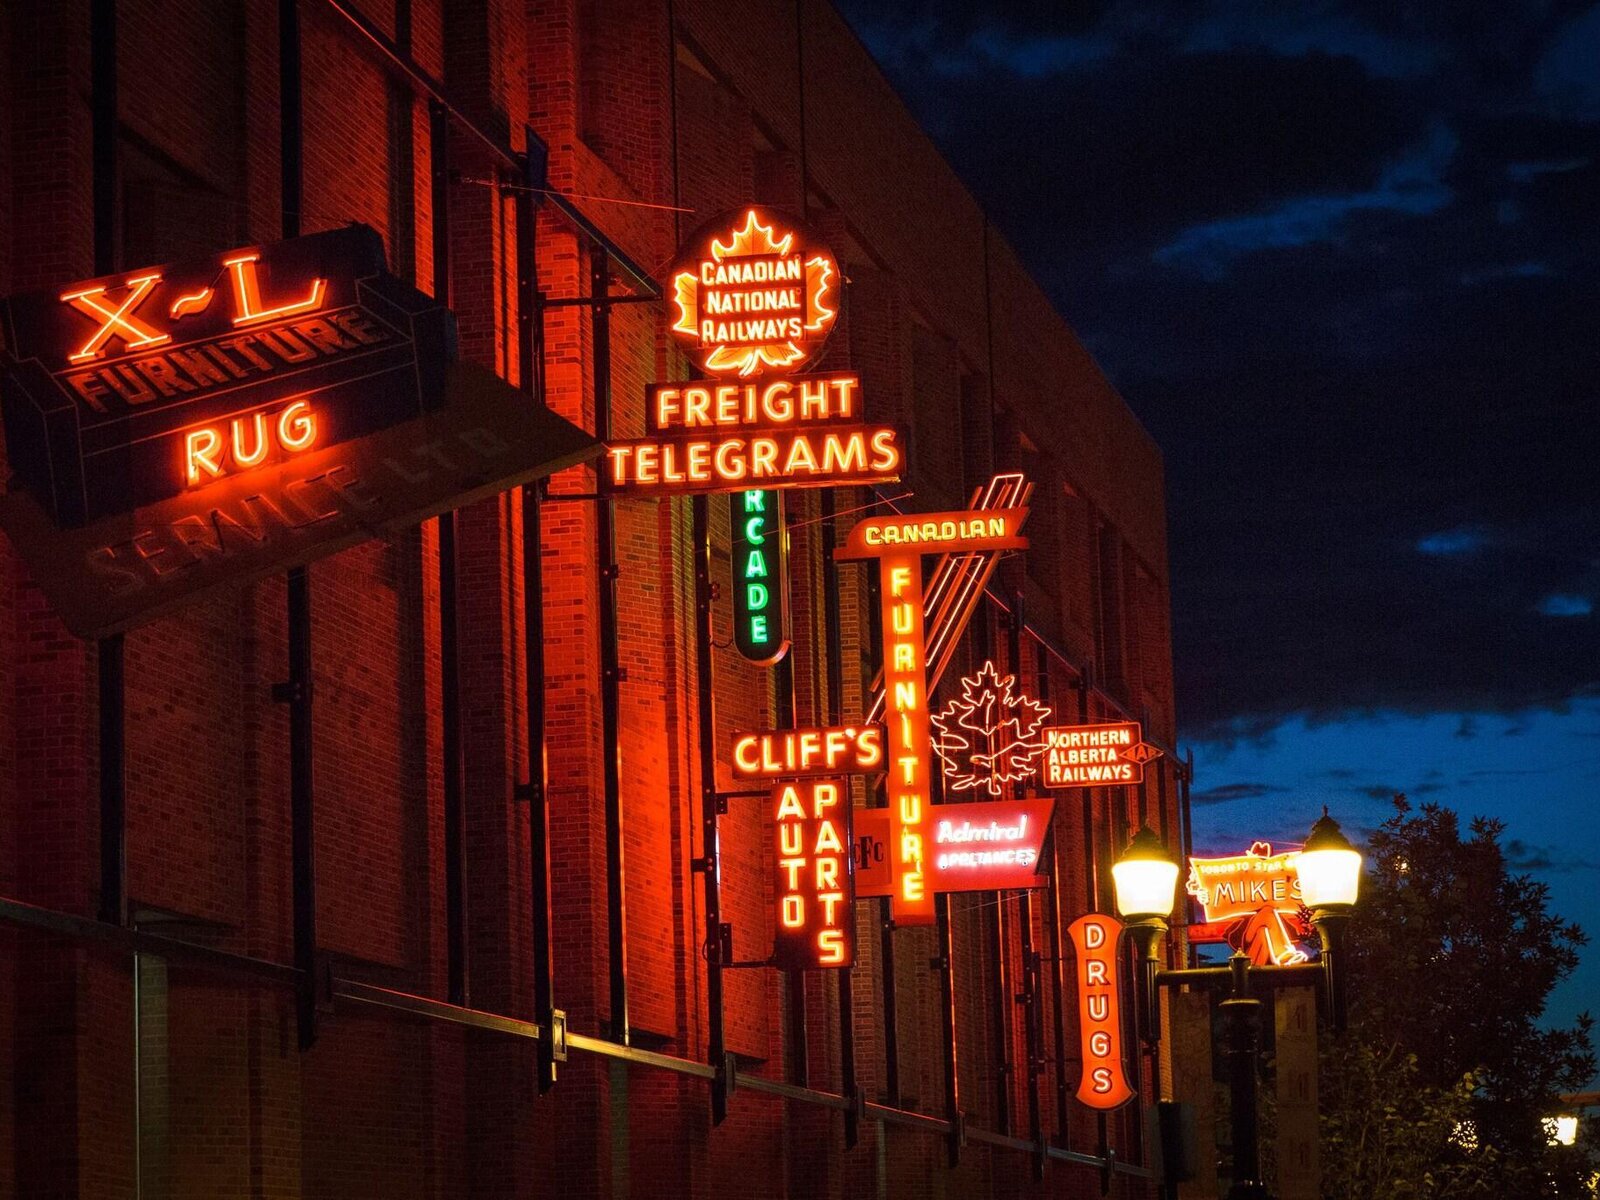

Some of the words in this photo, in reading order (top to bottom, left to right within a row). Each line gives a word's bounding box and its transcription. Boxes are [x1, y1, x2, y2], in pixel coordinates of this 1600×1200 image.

[701, 258, 801, 285] CANADIAN
[706, 288, 801, 314] NATIONAL
[701, 317, 801, 343] RAILWAYS
[67, 308, 389, 412] FURNITURE
[656, 376, 858, 429] FREIGHT
[184, 400, 318, 484] RUG
[609, 429, 899, 485] TELEGRAMS
[864, 517, 1007, 546] CANADIAN
[735, 729, 881, 772] CLIFF'S
[891, 567, 924, 901] FURNITURE
[1048, 730, 1131, 748] NORTHERN
[1048, 747, 1118, 766] ALBERTA
[1049, 763, 1132, 783] RAILWAYS
[937, 814, 1028, 844] Admiral
[776, 786, 807, 930] AUTO
[813, 784, 845, 964] PARTS
[1084, 923, 1112, 1093] DRUGS
